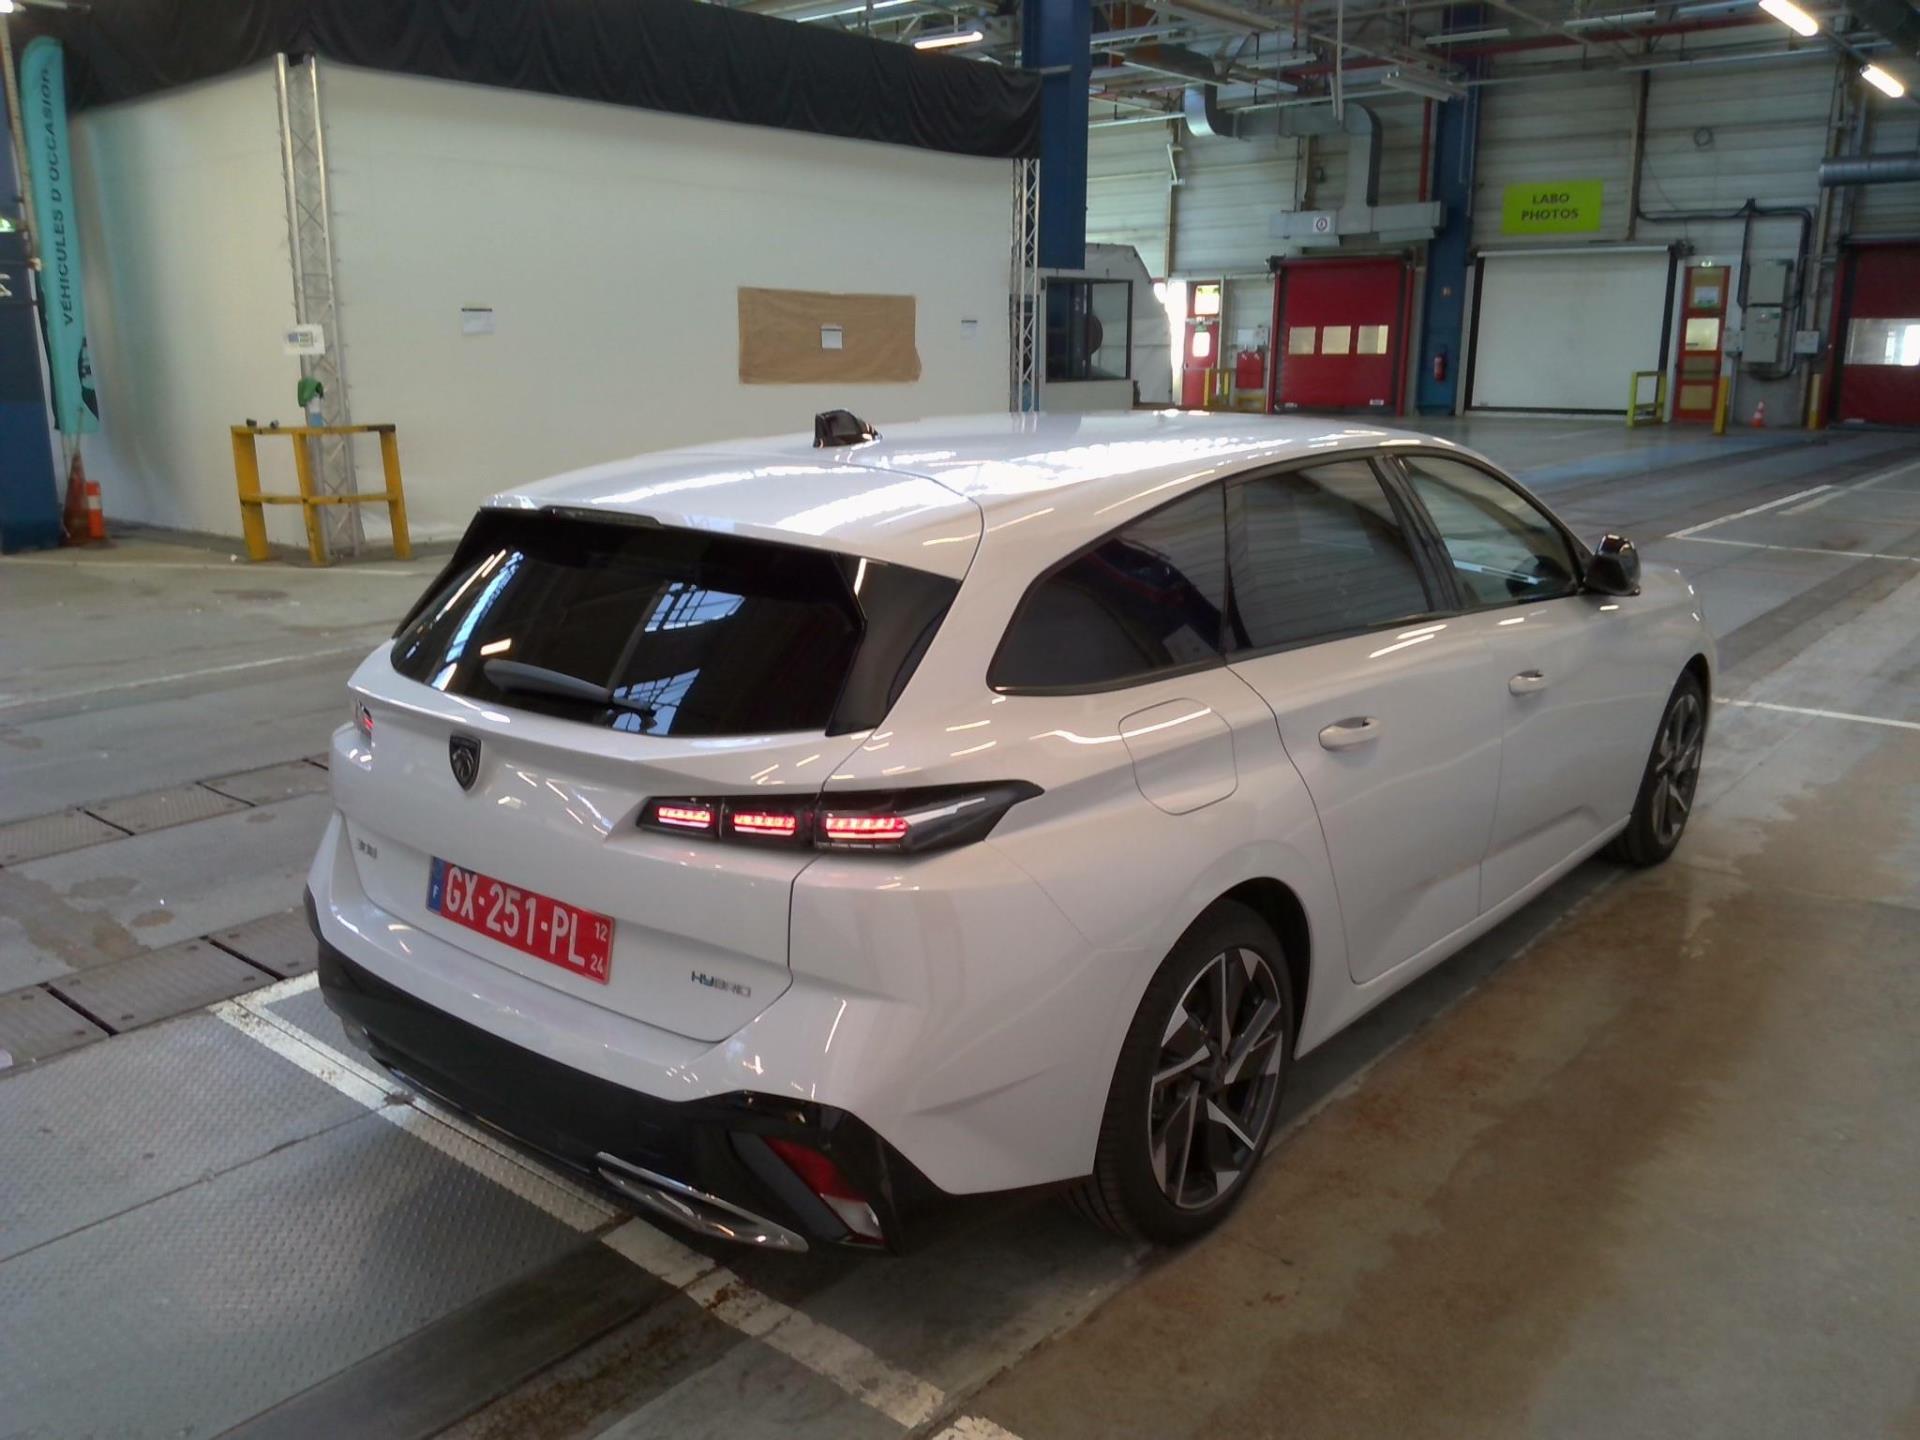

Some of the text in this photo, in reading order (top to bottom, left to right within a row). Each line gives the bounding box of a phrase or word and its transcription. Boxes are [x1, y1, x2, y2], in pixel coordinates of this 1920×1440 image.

[1532, 193, 1570, 206] LABO
[1521, 208, 1580, 221] PHOTOS
[432, 885, 439, 898] F
[594, 922, 608, 942] 12
[590, 955, 604, 974] 24
